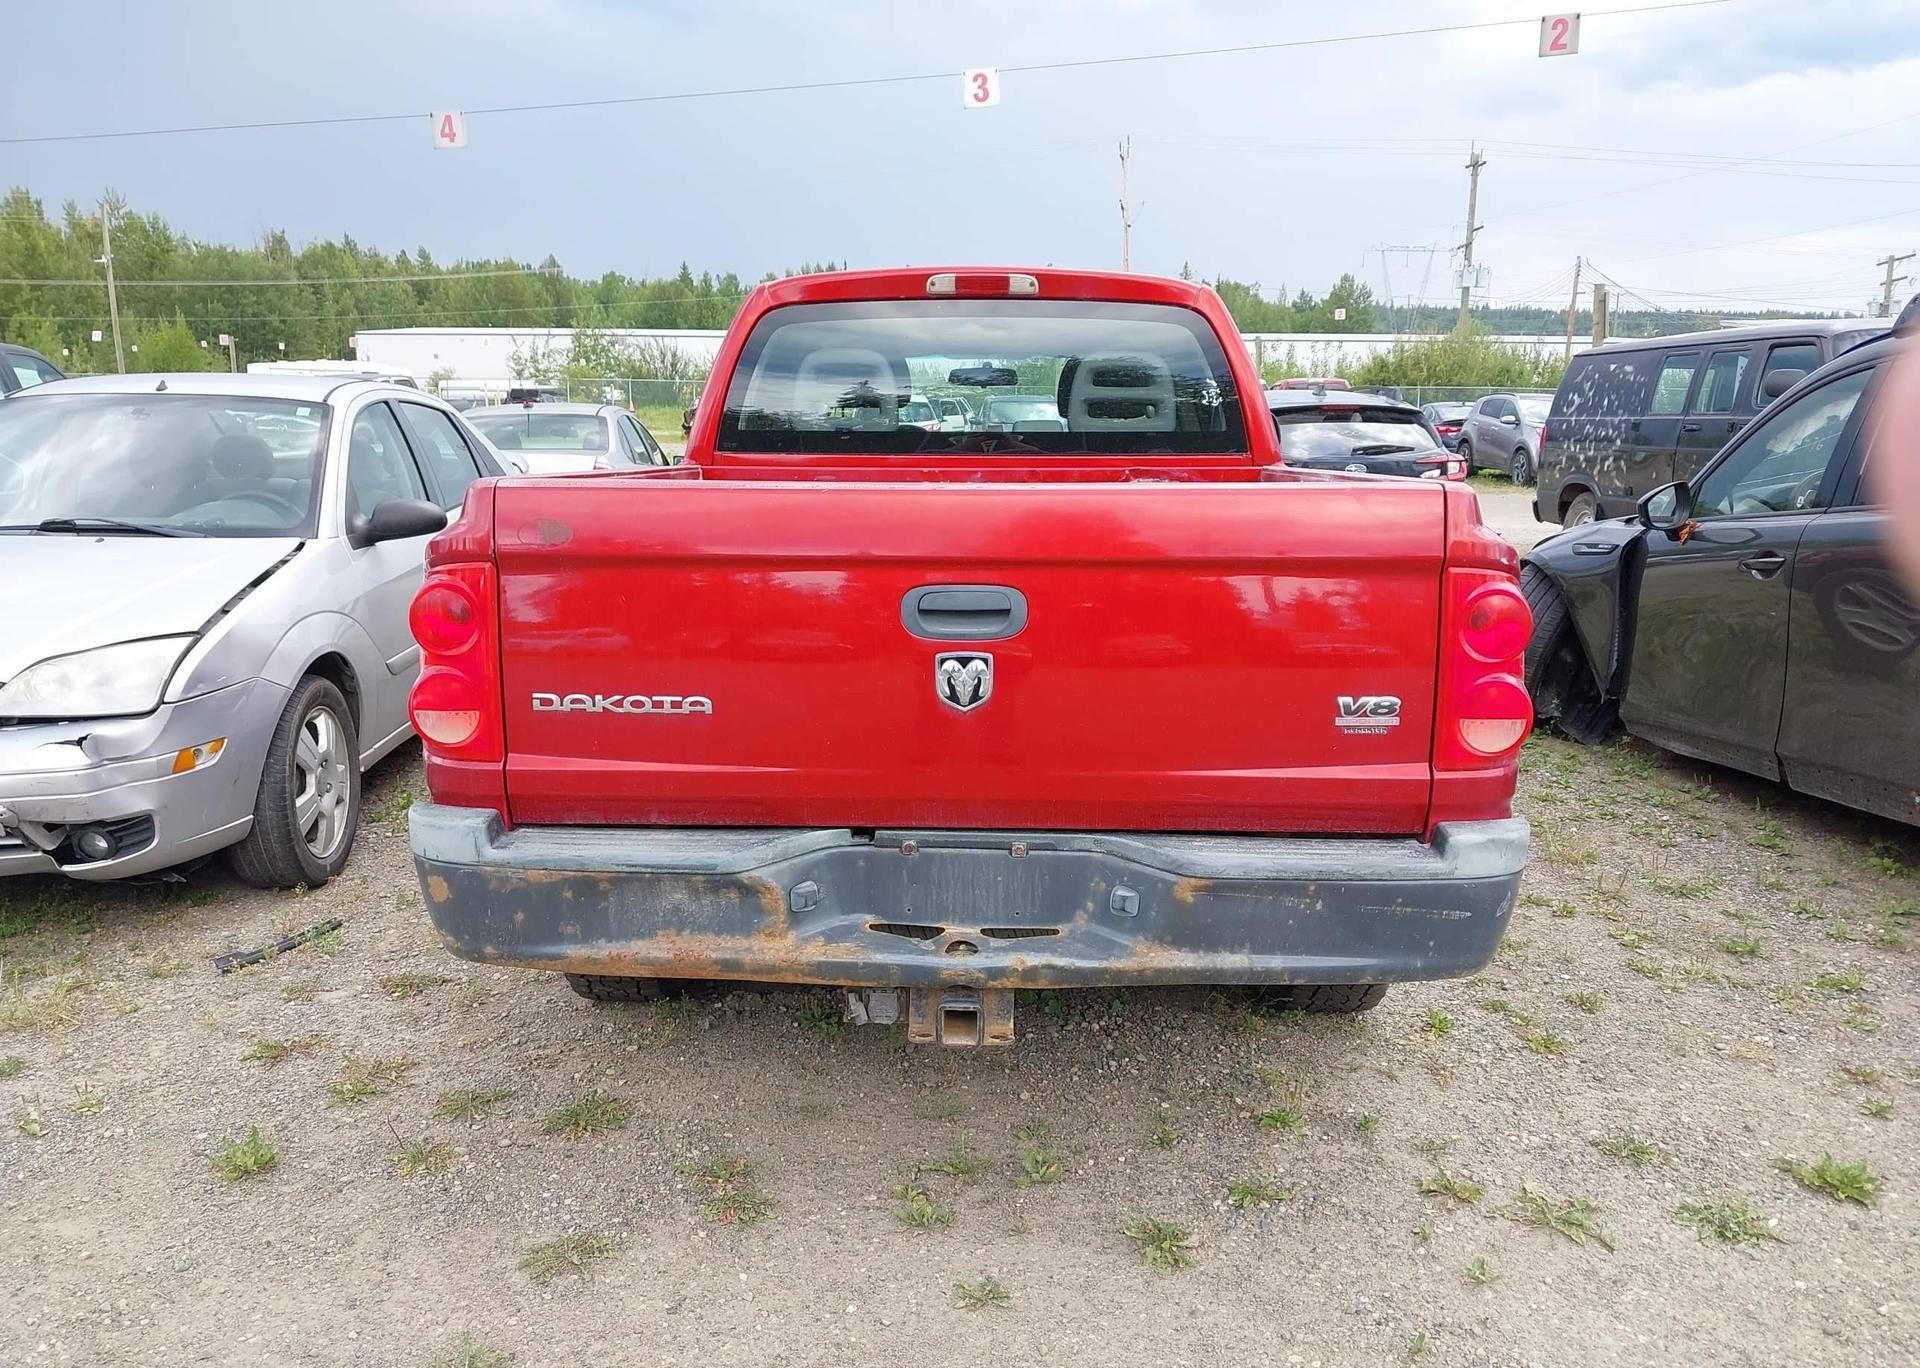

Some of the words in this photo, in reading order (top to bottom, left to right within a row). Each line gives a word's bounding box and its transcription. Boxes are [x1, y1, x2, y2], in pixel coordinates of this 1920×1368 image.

[1550, 18, 1569, 51] 2
[972, 73, 989, 103] 3
[440, 114, 457, 143] 4
[531, 692, 713, 714] DAKOTA
[1337, 695, 1402, 717] V8
